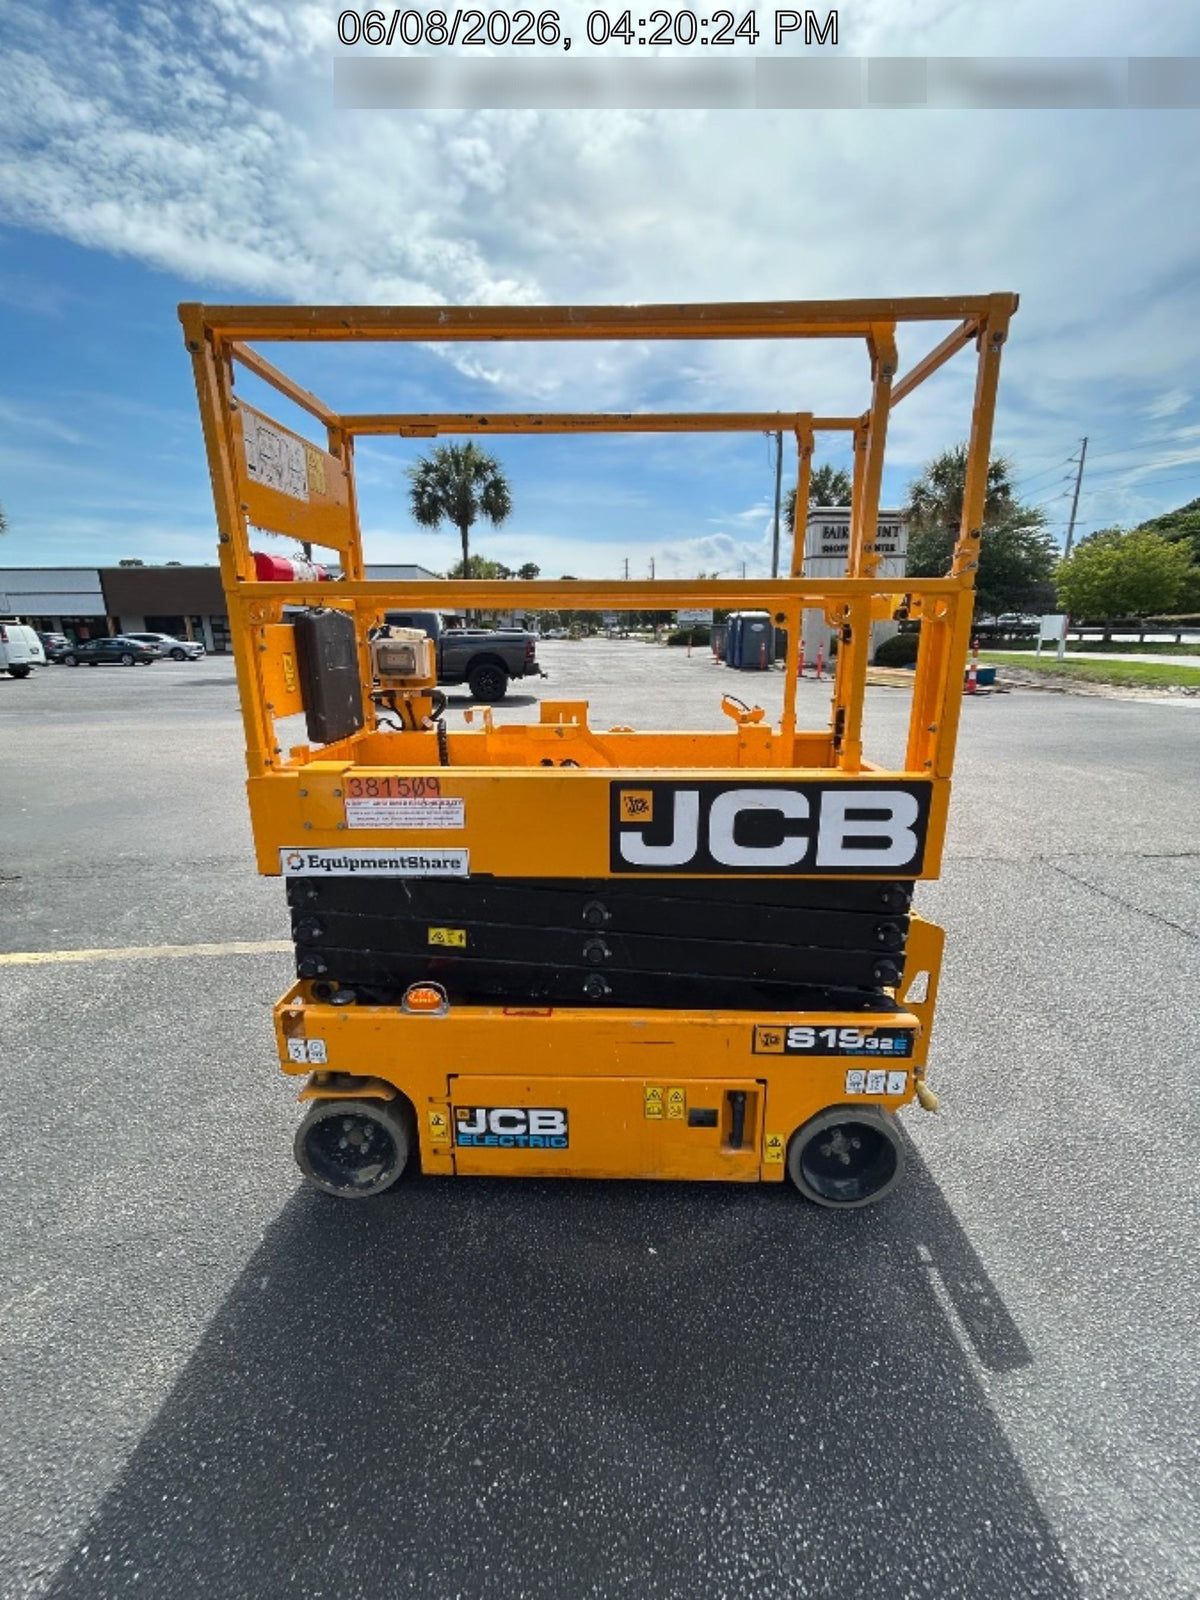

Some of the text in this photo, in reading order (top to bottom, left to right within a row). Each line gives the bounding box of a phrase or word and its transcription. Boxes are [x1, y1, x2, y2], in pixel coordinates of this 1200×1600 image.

[349, 777, 441, 799] 381509
[619, 788, 919, 867] JCB
[307, 854, 462, 872] EquipmentShare
[457, 1108, 568, 1135] JCB
[458, 1134, 568, 1148] ELECTRIC
